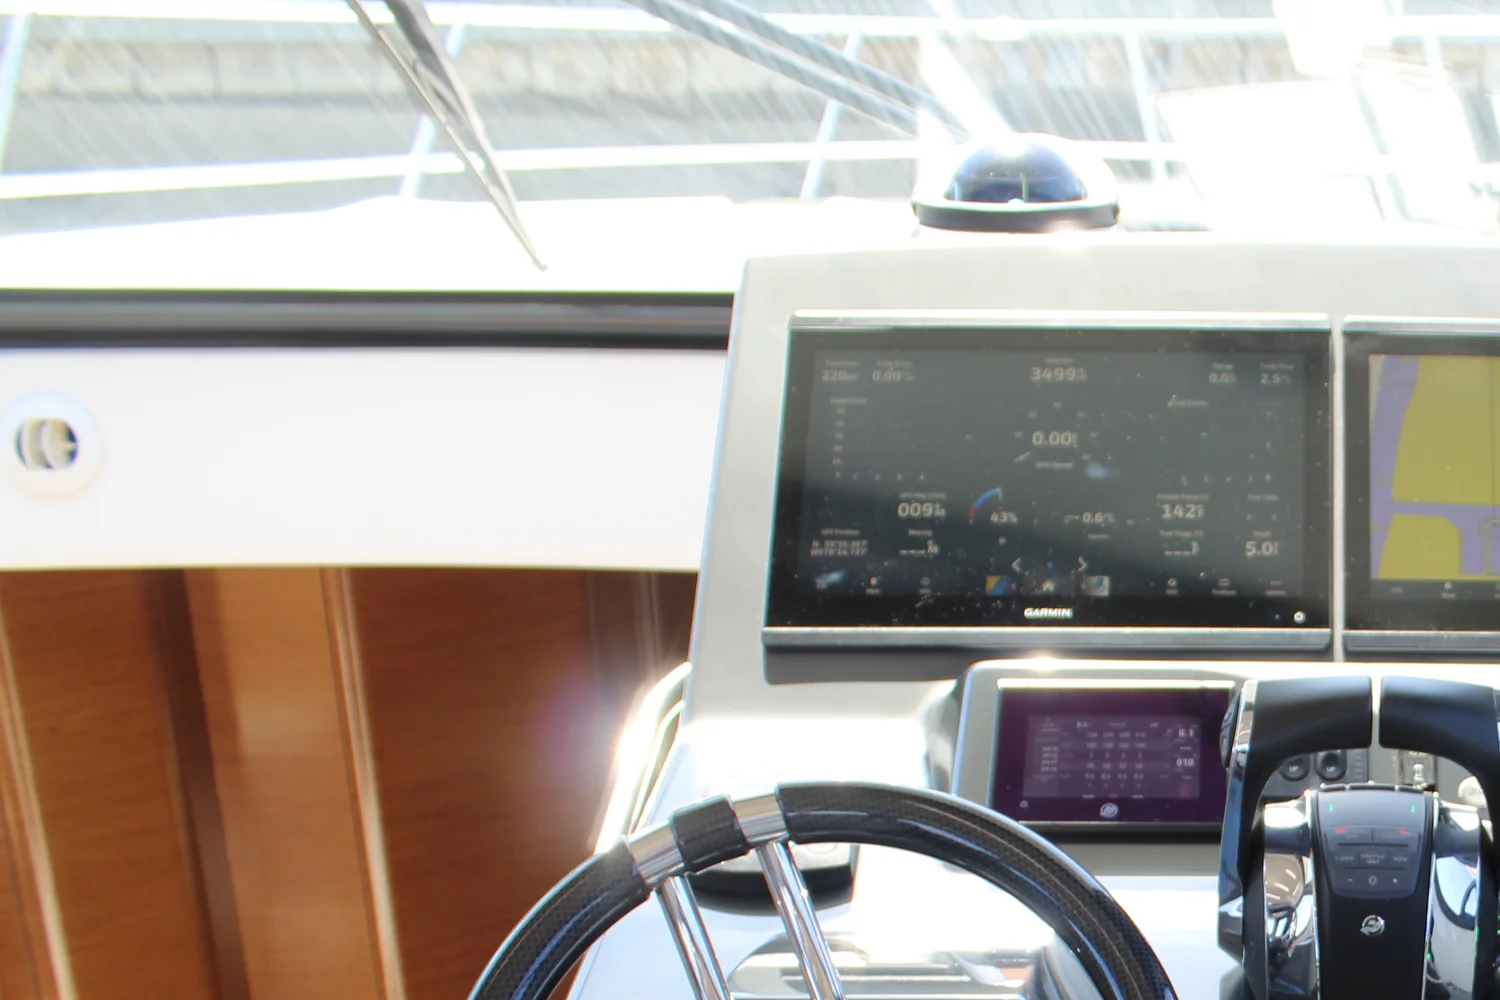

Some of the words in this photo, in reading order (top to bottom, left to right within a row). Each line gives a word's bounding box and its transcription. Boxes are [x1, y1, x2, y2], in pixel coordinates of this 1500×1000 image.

[1032, 431, 1072, 445] 0.00
[897, 502, 933, 518] 009
[1160, 503, 1197, 519] 142
[1023, 607, 1074, 619] GARMIN
